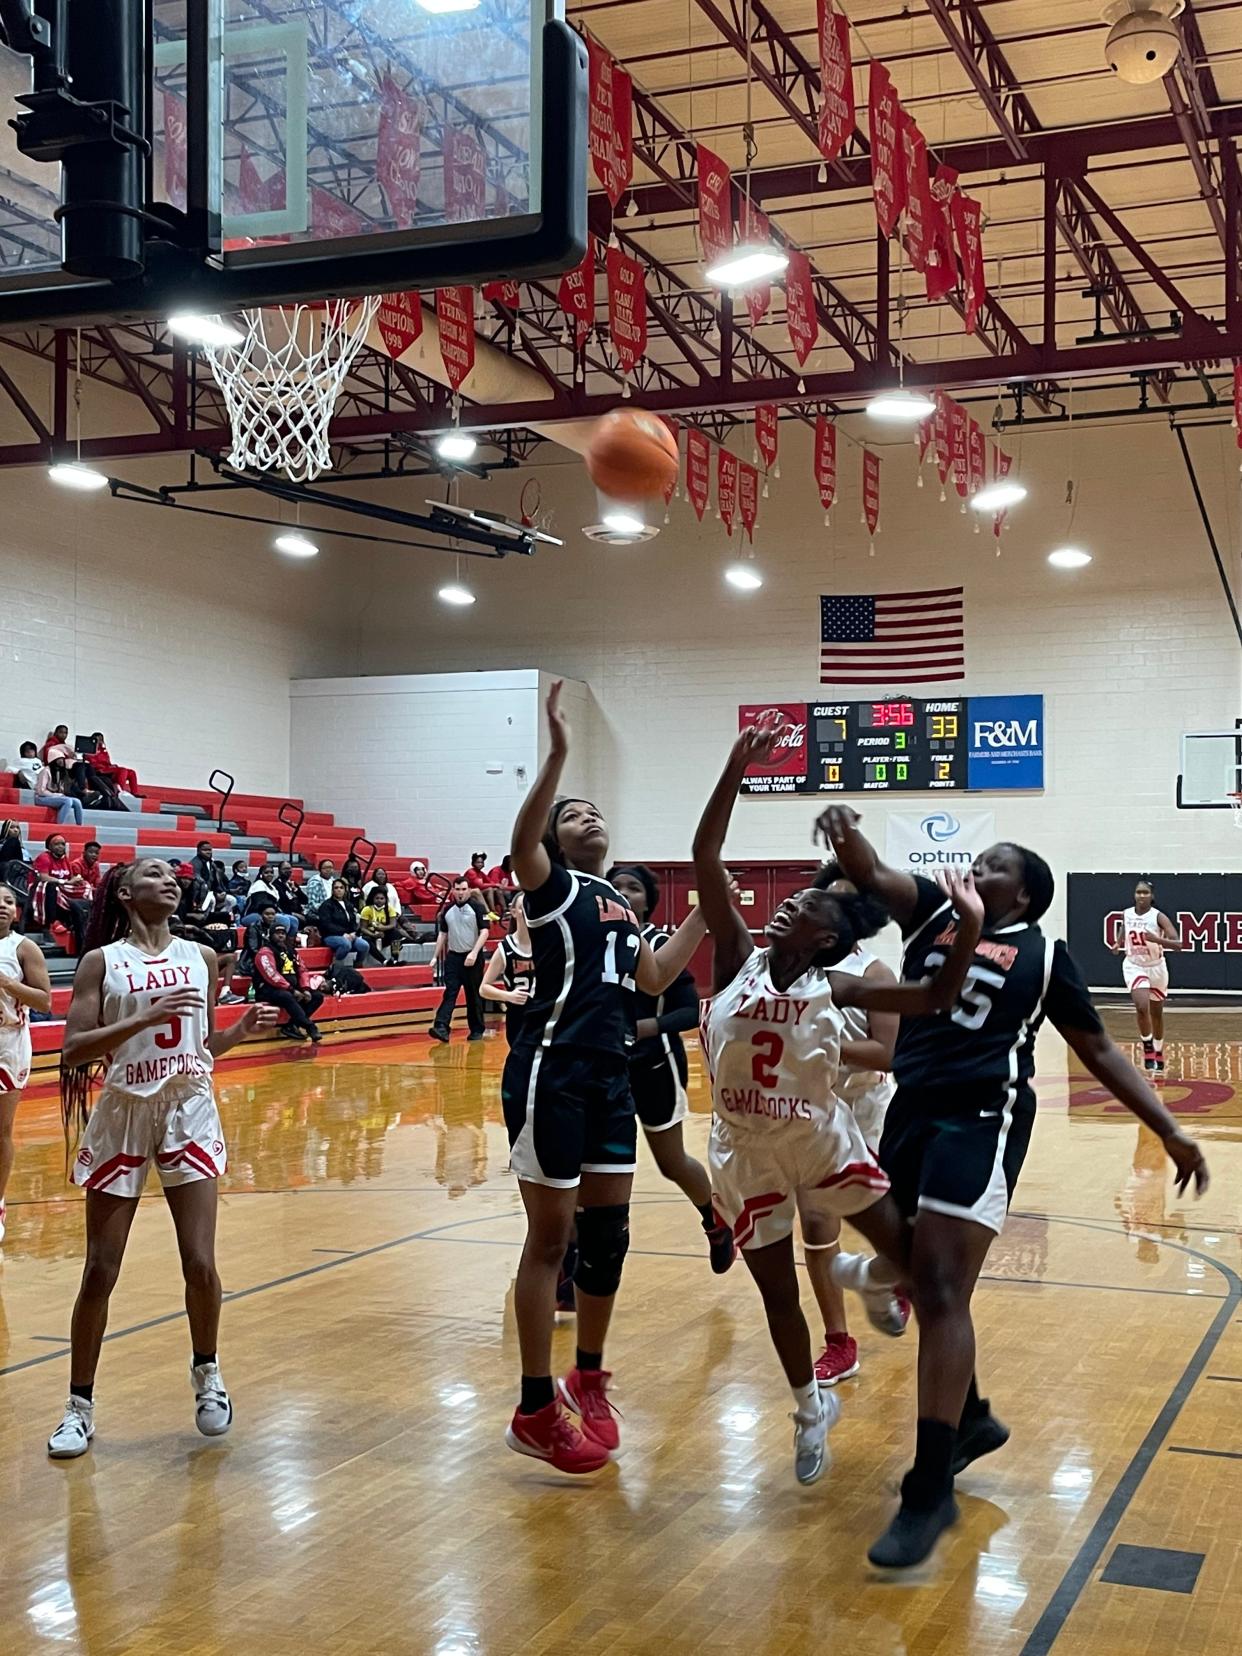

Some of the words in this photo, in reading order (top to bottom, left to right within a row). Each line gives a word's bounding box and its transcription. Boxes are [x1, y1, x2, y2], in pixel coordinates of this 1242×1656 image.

[813, 706, 850, 717] GUEST
[925, 702, 959, 713] HOME
[872, 703, 914, 727] 3:56
[931, 715, 958, 738] 33
[974, 719, 1038, 748] F&M
[857, 737, 890, 747] PERIOD
[894, 732, 906, 750] 3
[821, 757, 843, 765] FOULS
[931, 754, 954, 762] FOULS
[938, 762, 950, 780] 2
[741, 776, 773, 785] ALWAYS
[773, 776, 795, 784] PART
[795, 776, 807, 784] OF
[819, 782, 844, 790] POINTS
[863, 781, 889, 789] MATCH
[929, 780, 955, 788] POINTS
[749, 784, 770, 792] YOUR
[770, 783, 796, 792] TEAM!
[908, 850, 972, 865] optim
[126, 966, 191, 994] LADY
[733, 994, 810, 1026] LADY
[751, 1029, 785, 1089] 2
[126, 1053, 207, 1086] GAMECOCKS
